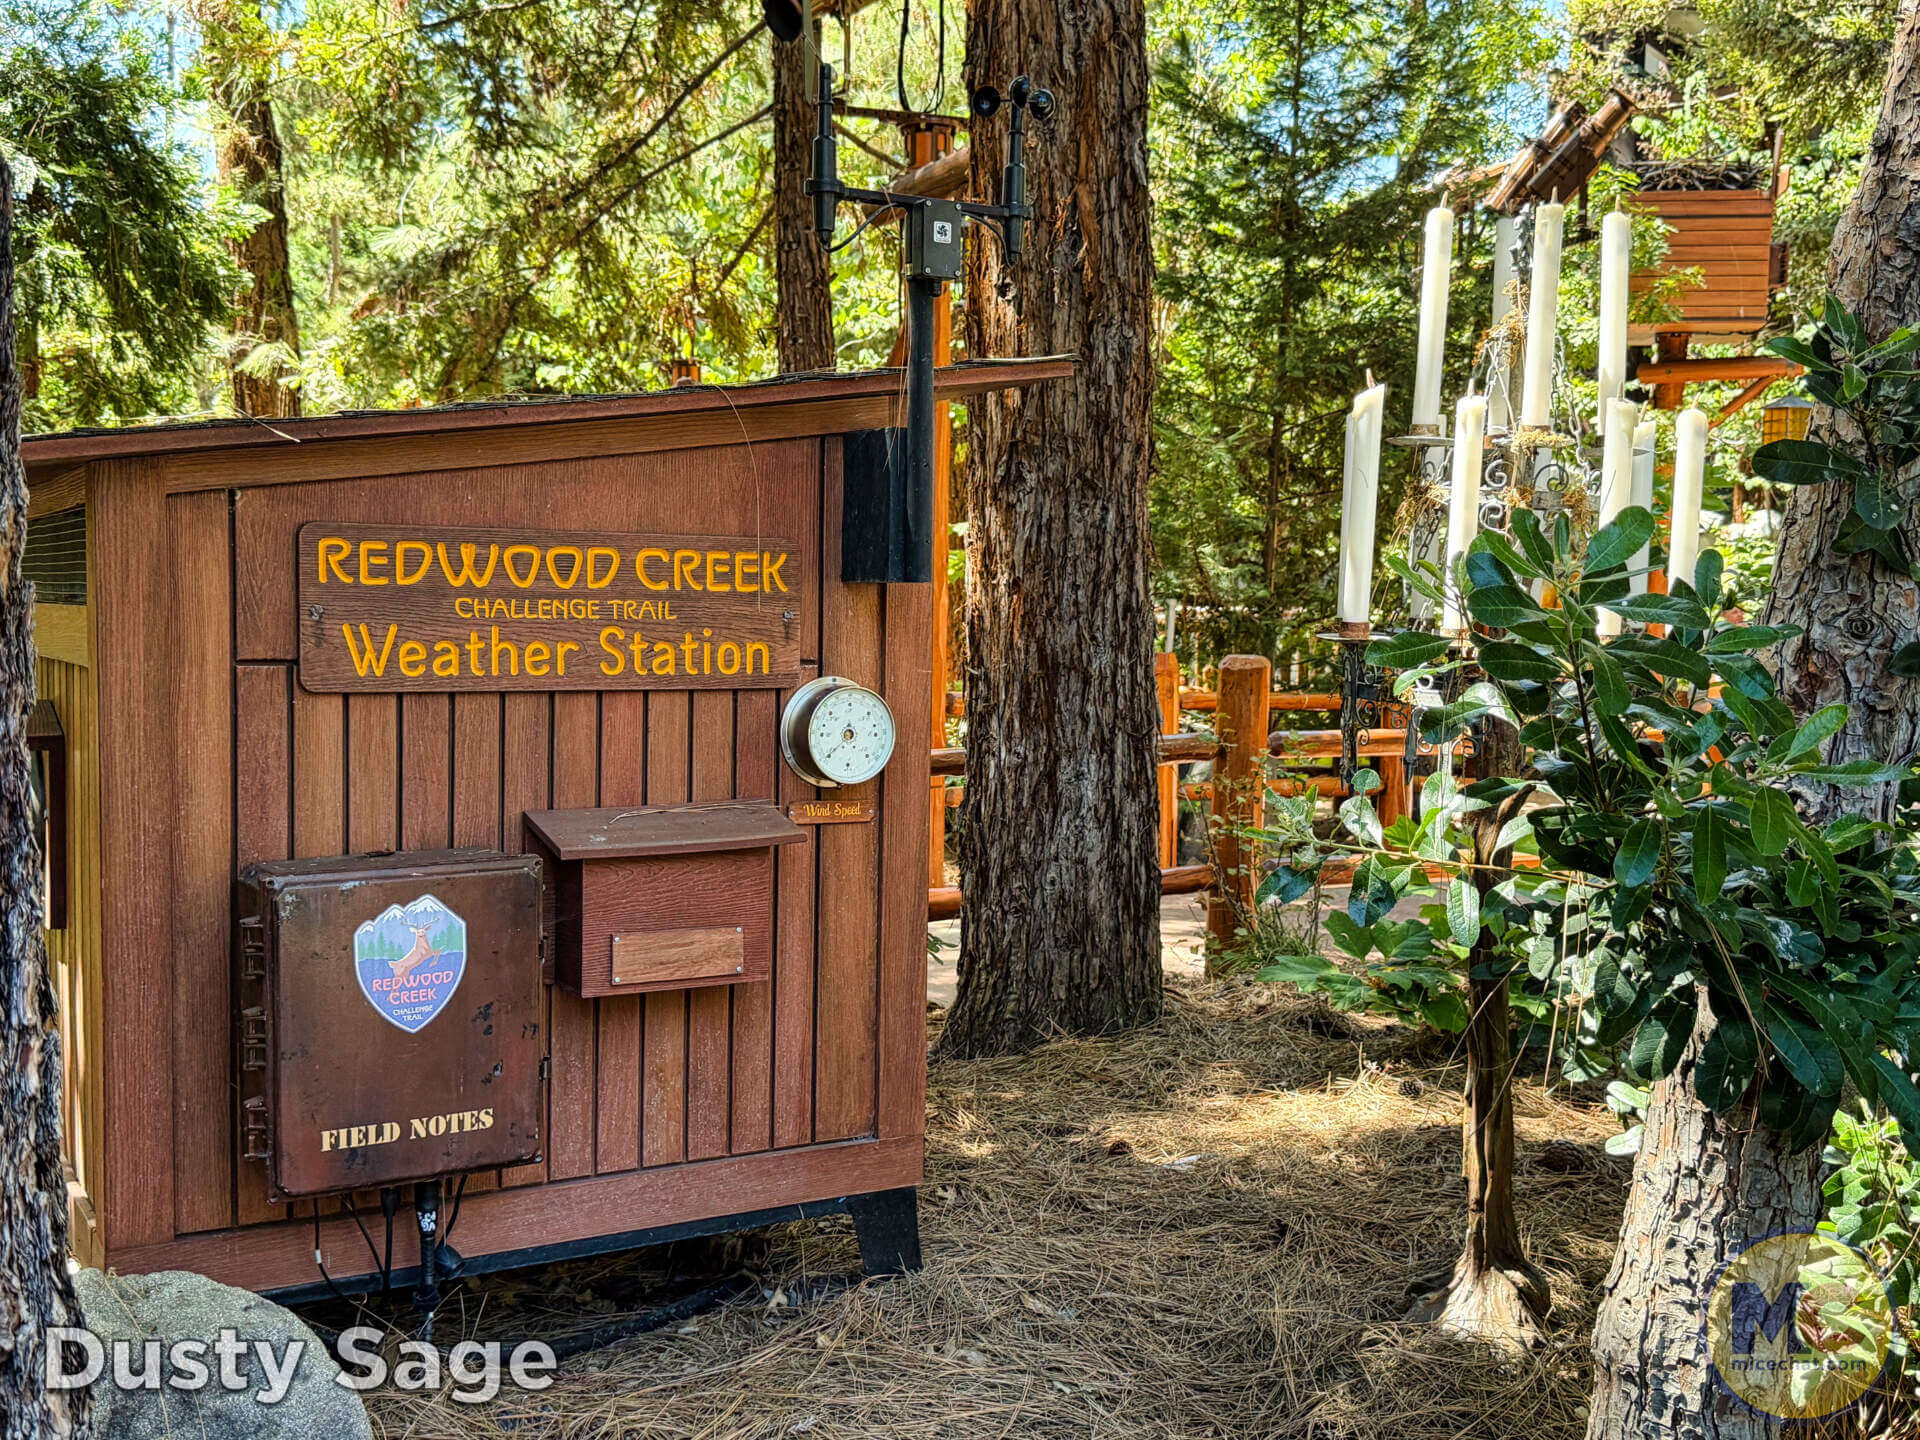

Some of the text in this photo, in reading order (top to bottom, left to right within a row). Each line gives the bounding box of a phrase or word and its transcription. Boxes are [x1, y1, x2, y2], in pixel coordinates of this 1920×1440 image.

[318, 537, 789, 593] REDWOOD CREEK
[455, 597, 678, 620] CHALLENGE TRAIL
[342, 622, 770, 678] Weather Station
[803, 802, 861, 817] Wind Speed
[372, 970, 454, 992] REDWOOD
[389, 987, 438, 1005] CREEK
[393, 1004, 433, 1016] CHALLENGE
[402, 1014, 424, 1022] TRAIL
[320, 1107, 494, 1152] FIELD NOTES
